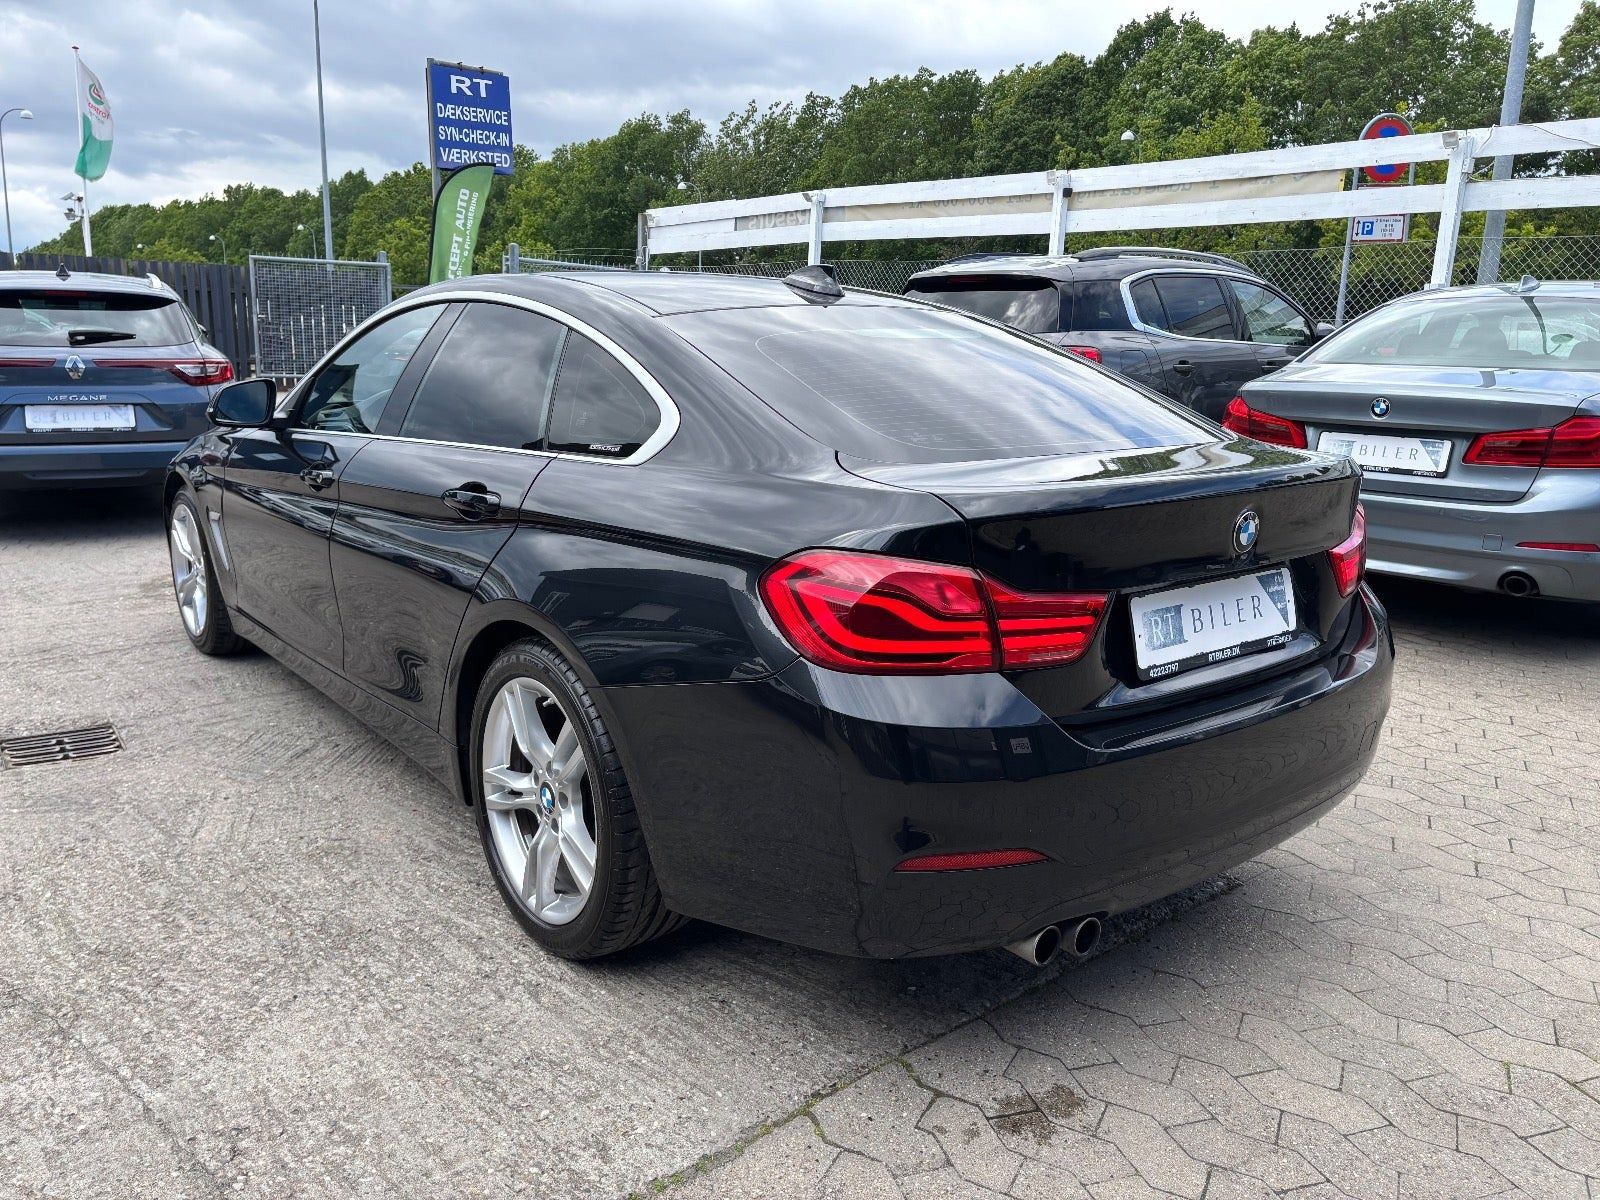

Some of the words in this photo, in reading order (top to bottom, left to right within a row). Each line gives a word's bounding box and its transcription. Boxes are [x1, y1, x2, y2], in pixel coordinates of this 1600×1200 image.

[450, 75, 492, 98] RT
[436, 103, 509, 126] DÆKSERVICE
[438, 126, 510, 147] SYN-CHECK-IN
[440, 147, 511, 168] VÆRKSTED
[456, 188, 470, 231] AUTO
[464, 191, 479, 250] FINANSIERING
[1358, 444, 1420, 461] BILER
[1150, 612, 1177, 643] RT
[1190, 595, 1264, 634] BILER
[1149, 662, 1179, 678] 42223797
[1208, 646, 1241, 663] RTBILER.DK
